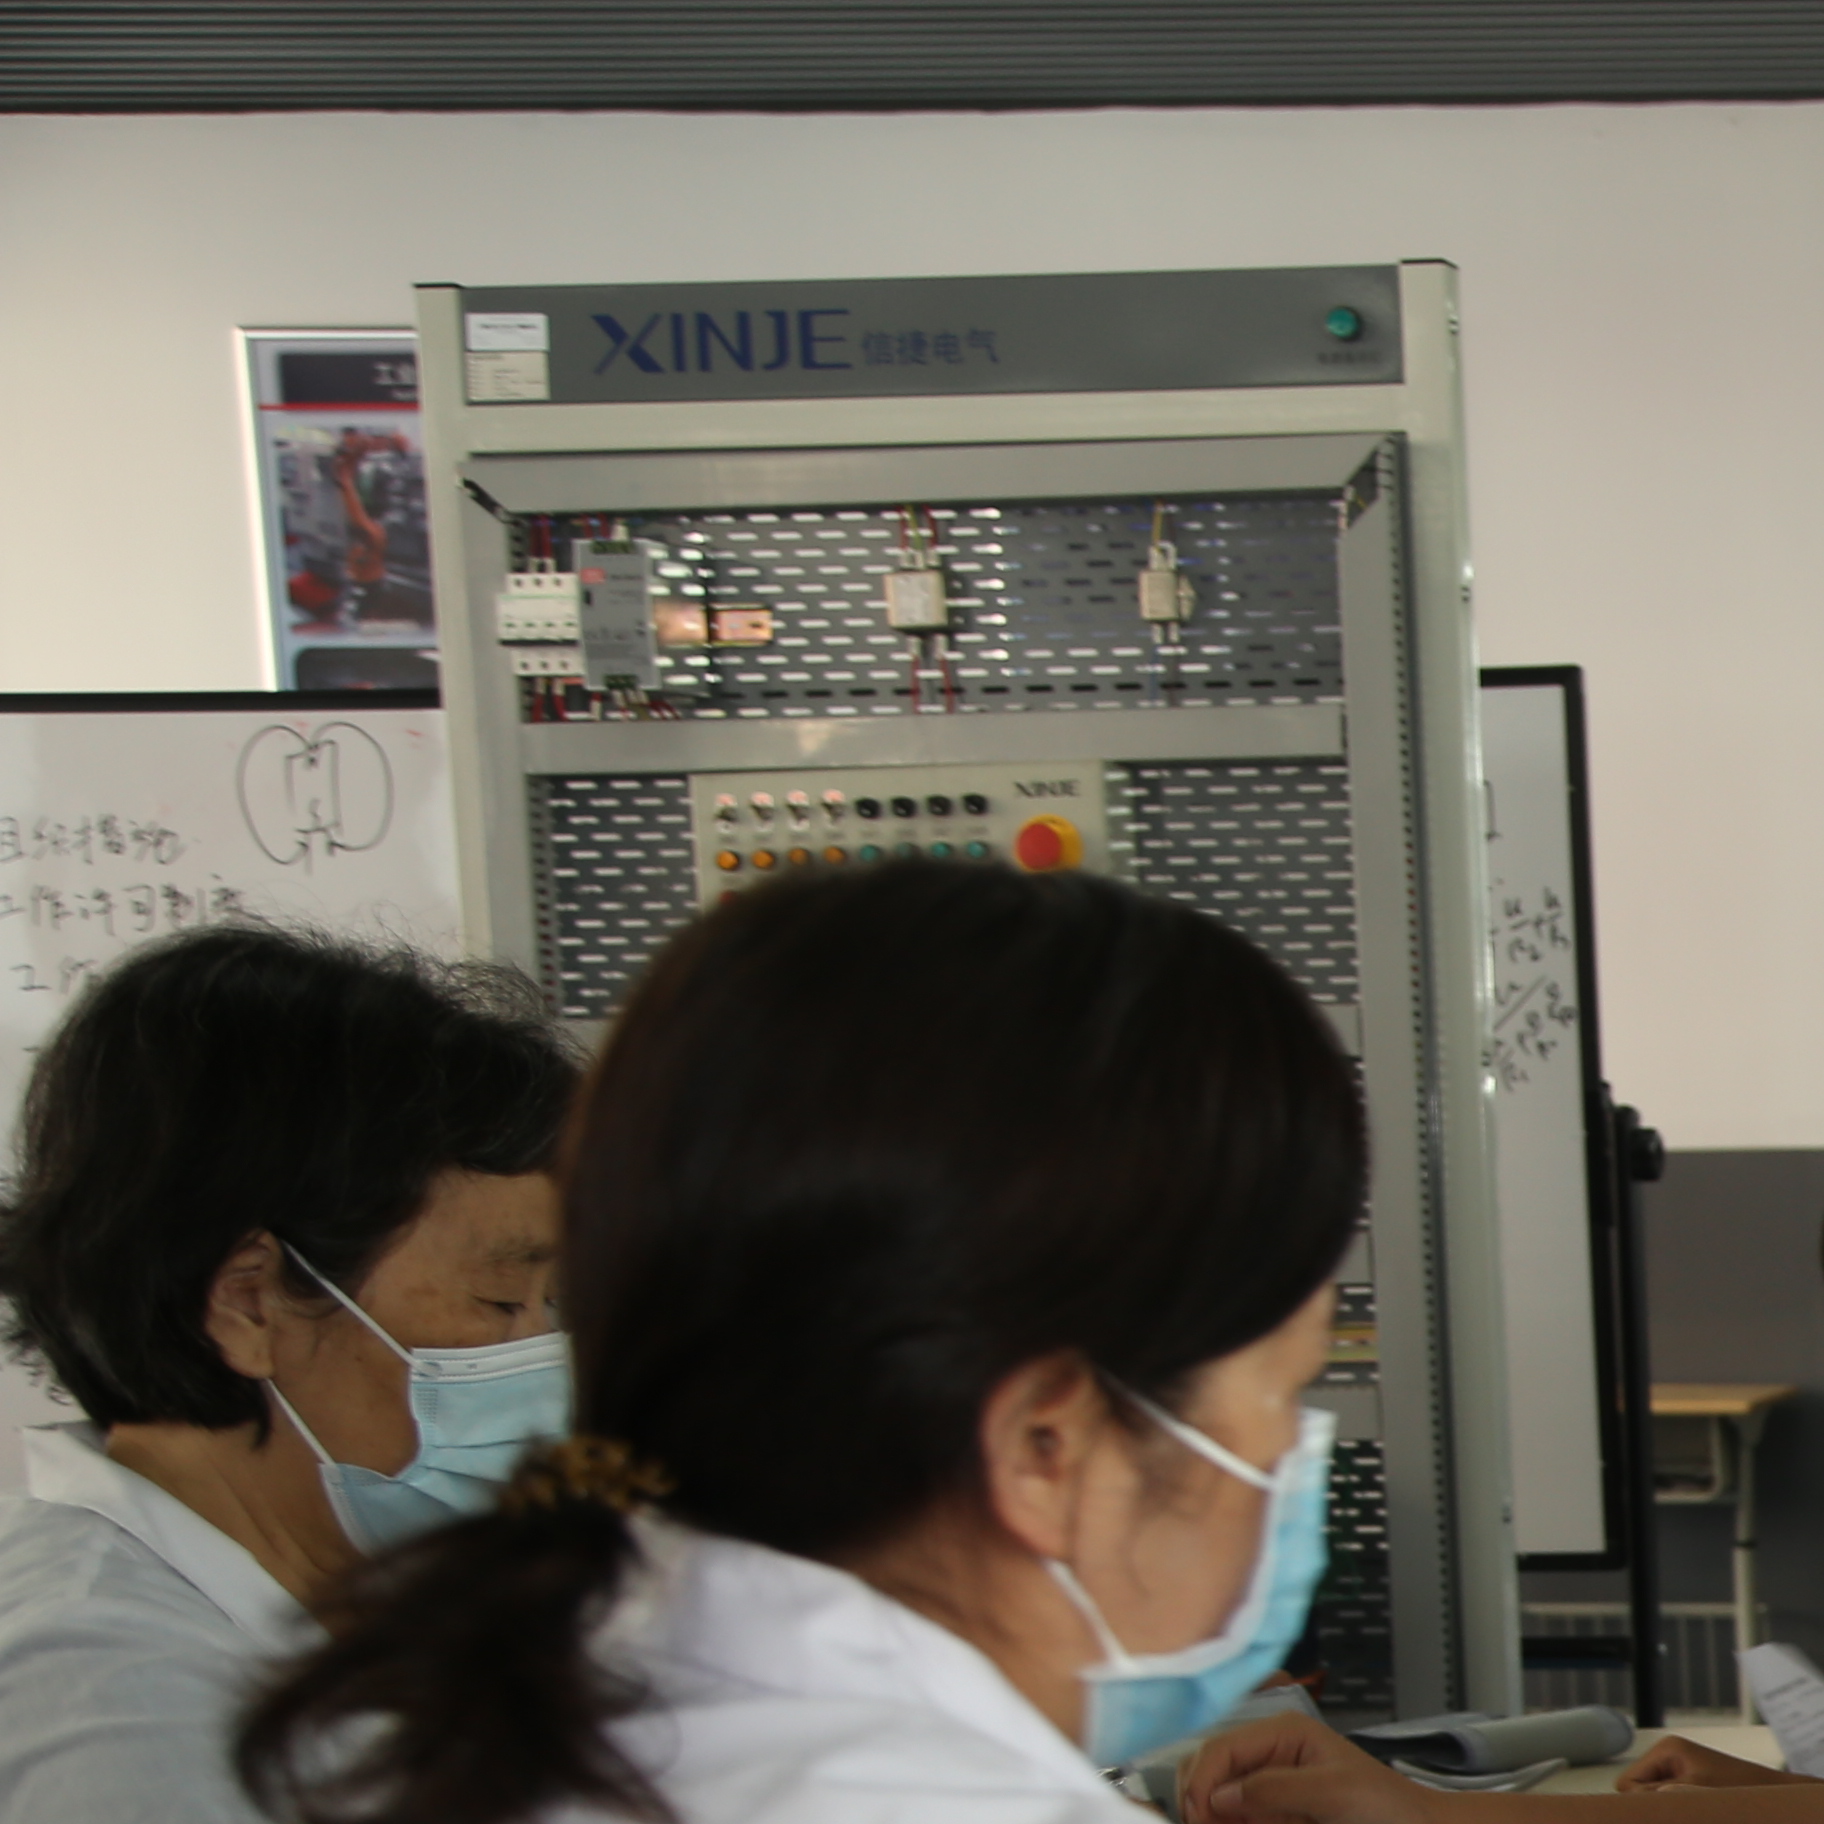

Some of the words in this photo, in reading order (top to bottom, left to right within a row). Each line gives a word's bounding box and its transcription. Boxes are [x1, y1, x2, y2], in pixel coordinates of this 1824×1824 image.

[590, 308, 853, 374] XINJE
[862, 328, 998, 367] 信捷电气
